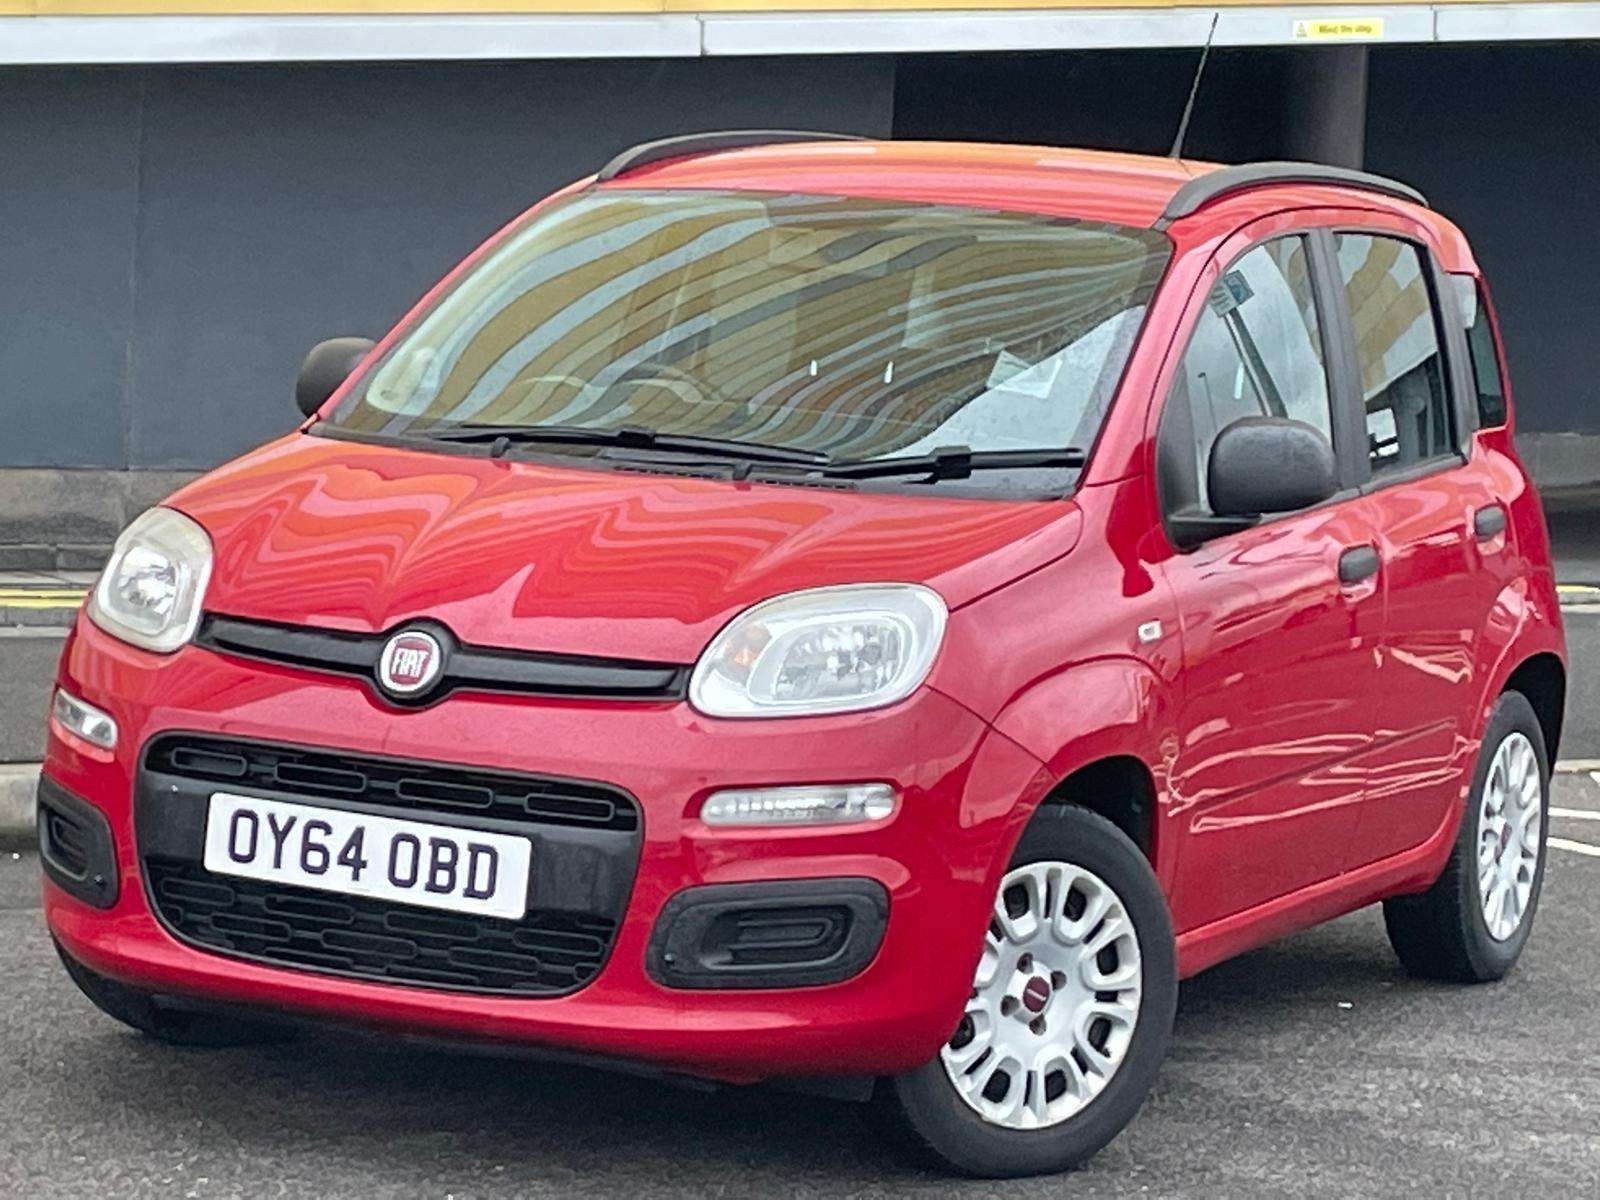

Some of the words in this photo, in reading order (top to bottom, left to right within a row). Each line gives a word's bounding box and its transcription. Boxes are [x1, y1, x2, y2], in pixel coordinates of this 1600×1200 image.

[391, 648, 429, 677] FIAT
[229, 808, 367, 881] OY64
[388, 833, 498, 900] OBD
